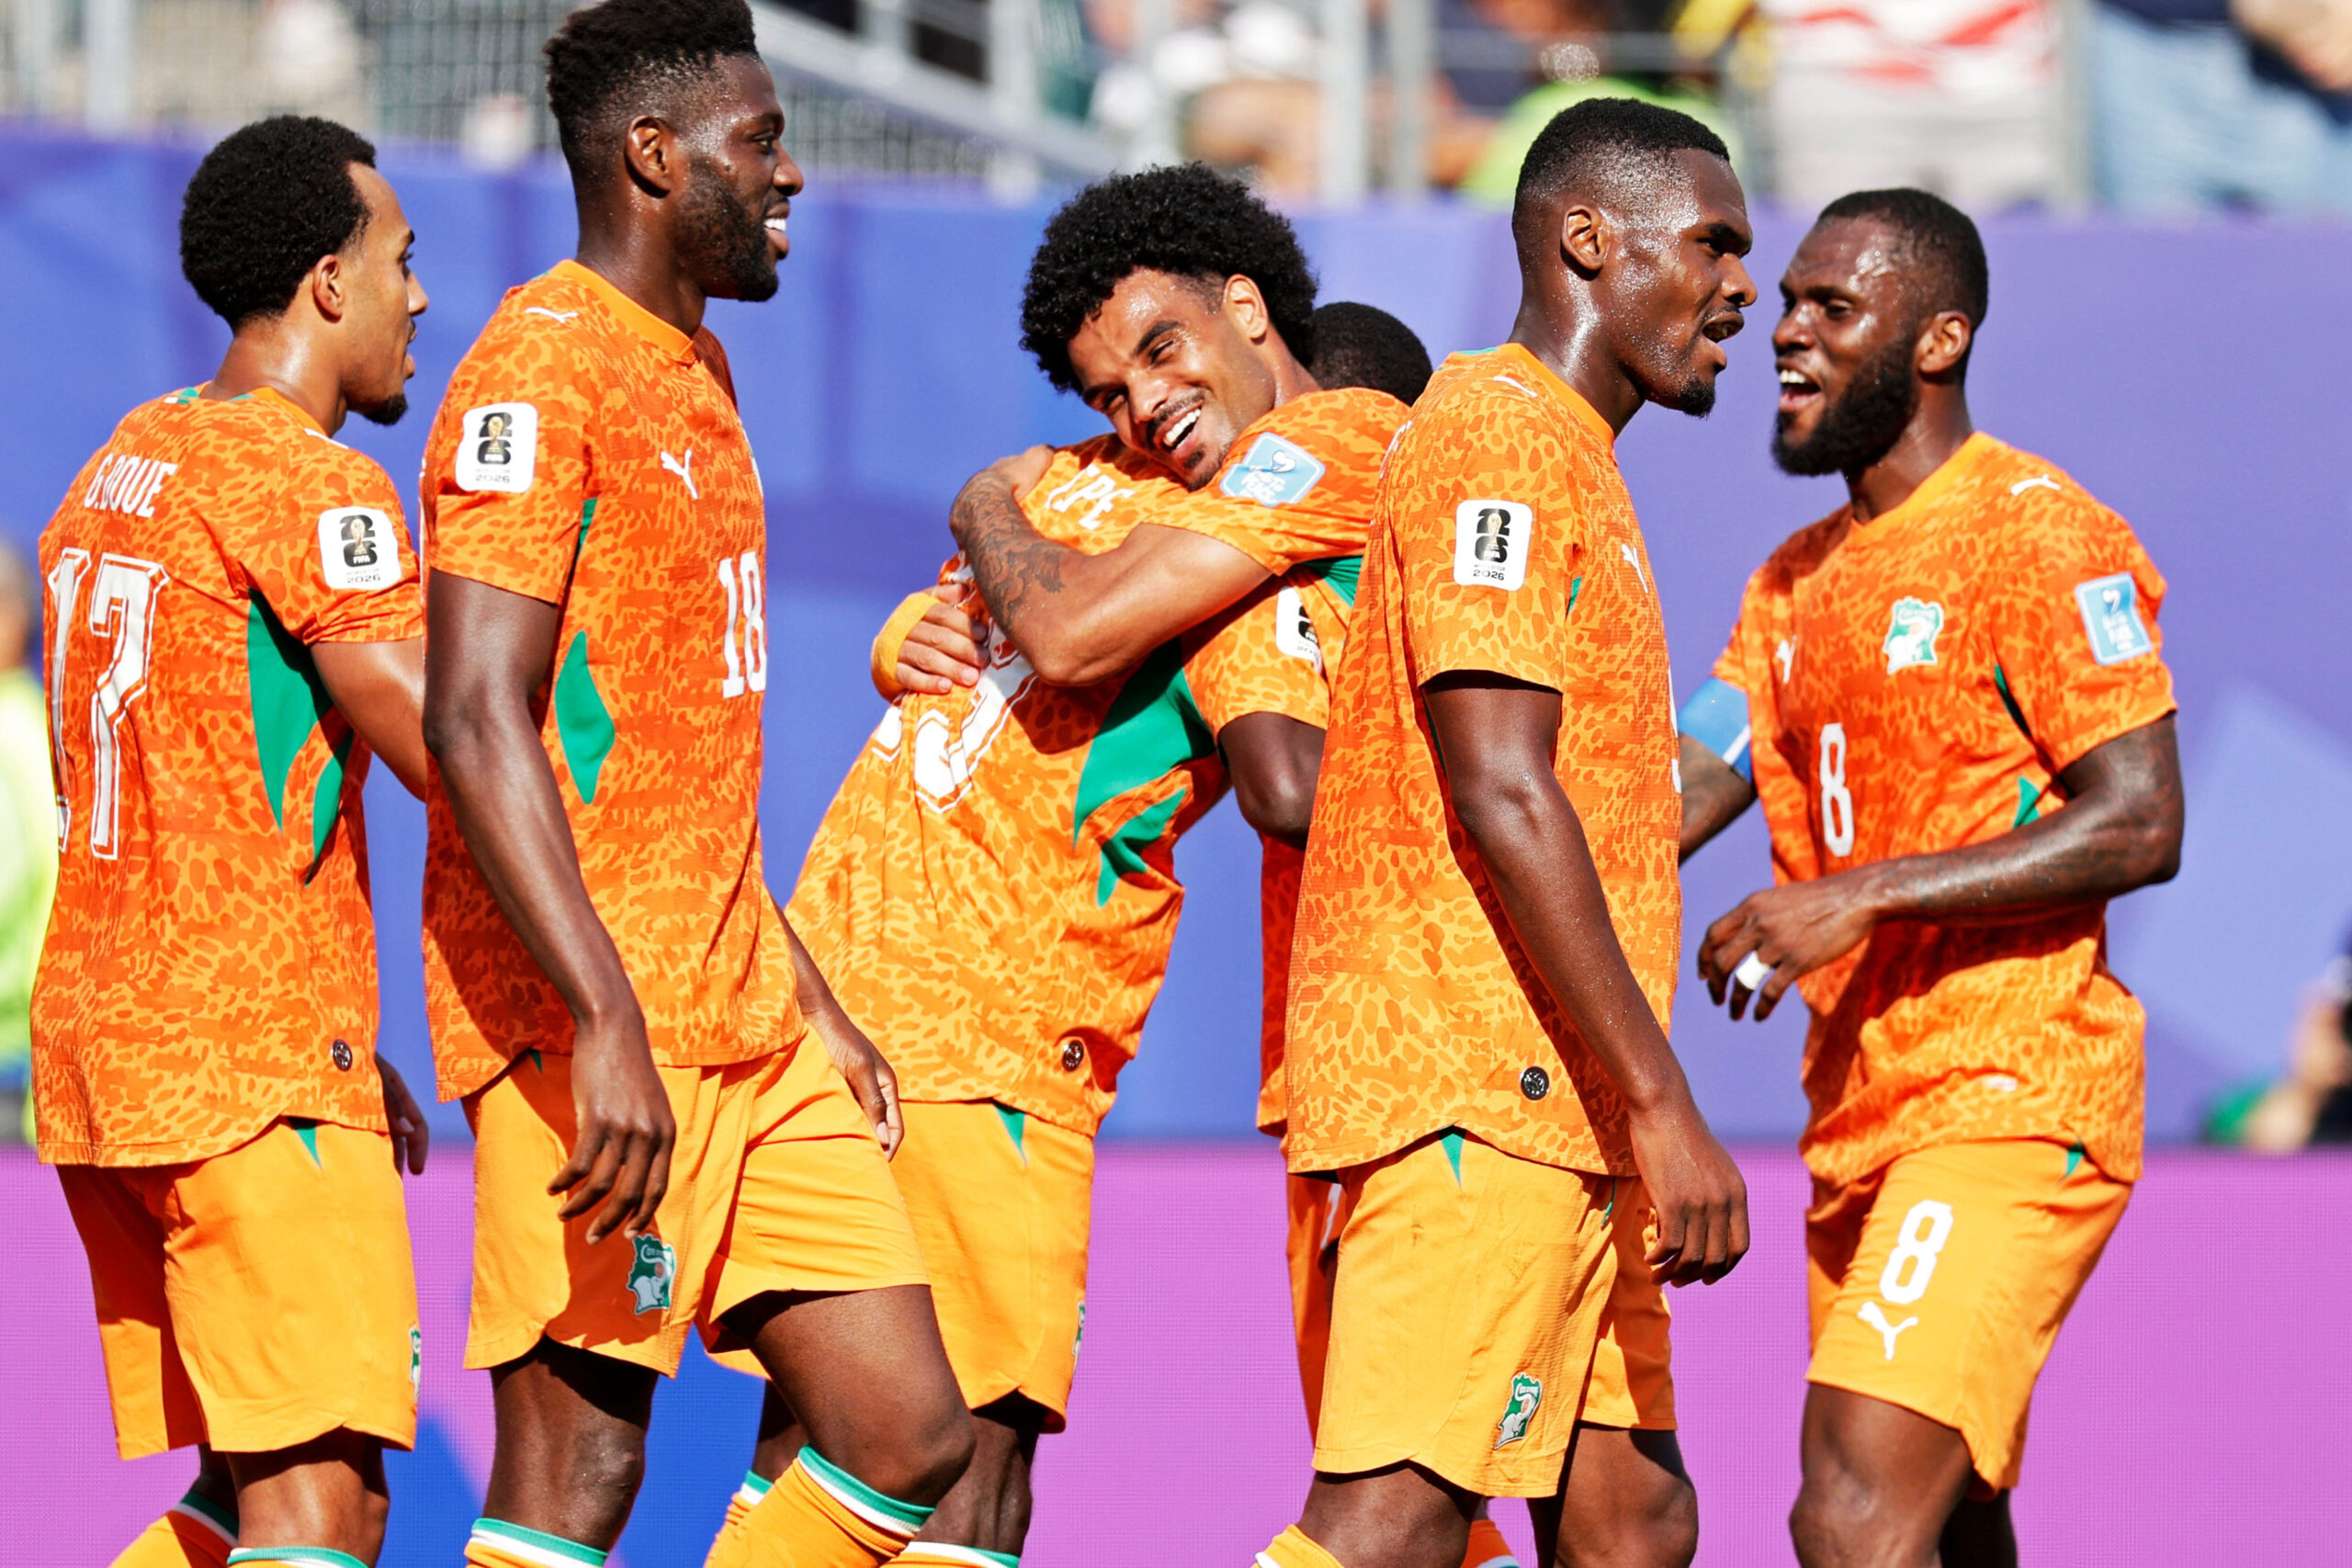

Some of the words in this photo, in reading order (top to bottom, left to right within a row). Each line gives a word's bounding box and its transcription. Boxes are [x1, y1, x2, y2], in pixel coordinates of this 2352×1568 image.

[476, 474, 511, 483] 2026
[346, 574, 380, 584] 2026
[718, 551, 767, 698] 18
[1473, 570, 1504, 581] 2026
[48, 547, 170, 861] 17
[1819, 722, 1854, 857] 8
[1879, 1200, 1954, 1304] 8
